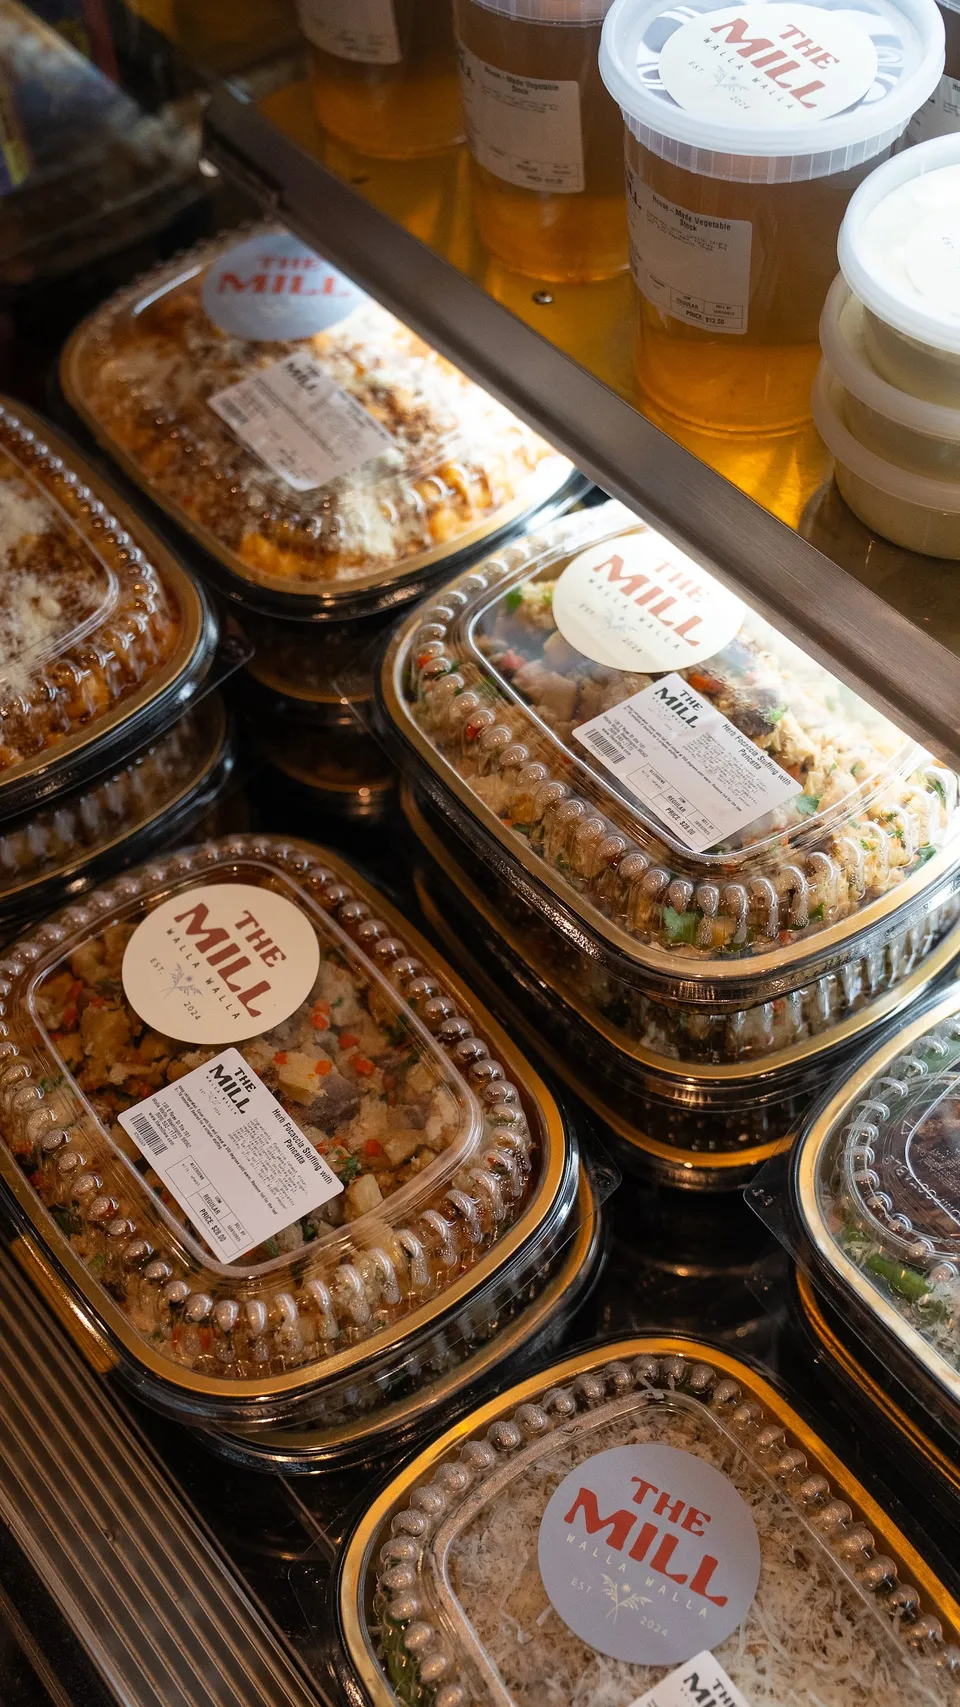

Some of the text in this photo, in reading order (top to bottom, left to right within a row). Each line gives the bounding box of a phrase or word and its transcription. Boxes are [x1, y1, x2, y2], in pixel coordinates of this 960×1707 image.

[704, 37, 794, 108] WALLA WALLA
[710, 18, 826, 108] MILL
[779, 24, 840, 69] THE
[694, 218, 731, 230] Vegetable
[216, 272, 352, 297] MILL
[259, 256, 325, 272] THE
[592, 554, 703, 647] MILL
[654, 557, 710, 603] THE
[654, 687, 702, 729] MILL
[680, 690, 702, 712] THE
[721, 723, 737, 736] Herb
[755, 754, 780, 775] Stuffing
[776, 773, 792, 786] with
[737, 748, 763, 770] Pancetta
[174, 902, 272, 1018] MILL
[234, 910, 286, 968] THE
[150, 957, 201, 1020] EST. 2024
[166, 928, 241, 1020] WALLA WALLA
[209, 1064, 251, 1114] MILL
[234, 1067, 256, 1093] THE
[271, 1108, 334, 1184] Herb Focaccia Stuffing with
[283, 1138, 307, 1164] Pancetta
[198, 1208, 227, 1242] PRICE: $28.00
[202, 1193, 220, 1215] REGULAR
[631, 1476, 712, 1536] THE
[564, 1487, 728, 1608] MILL
[566, 1533, 707, 1618] WALLA WALLA
[571, 1577, 669, 1637] EST. 2024
